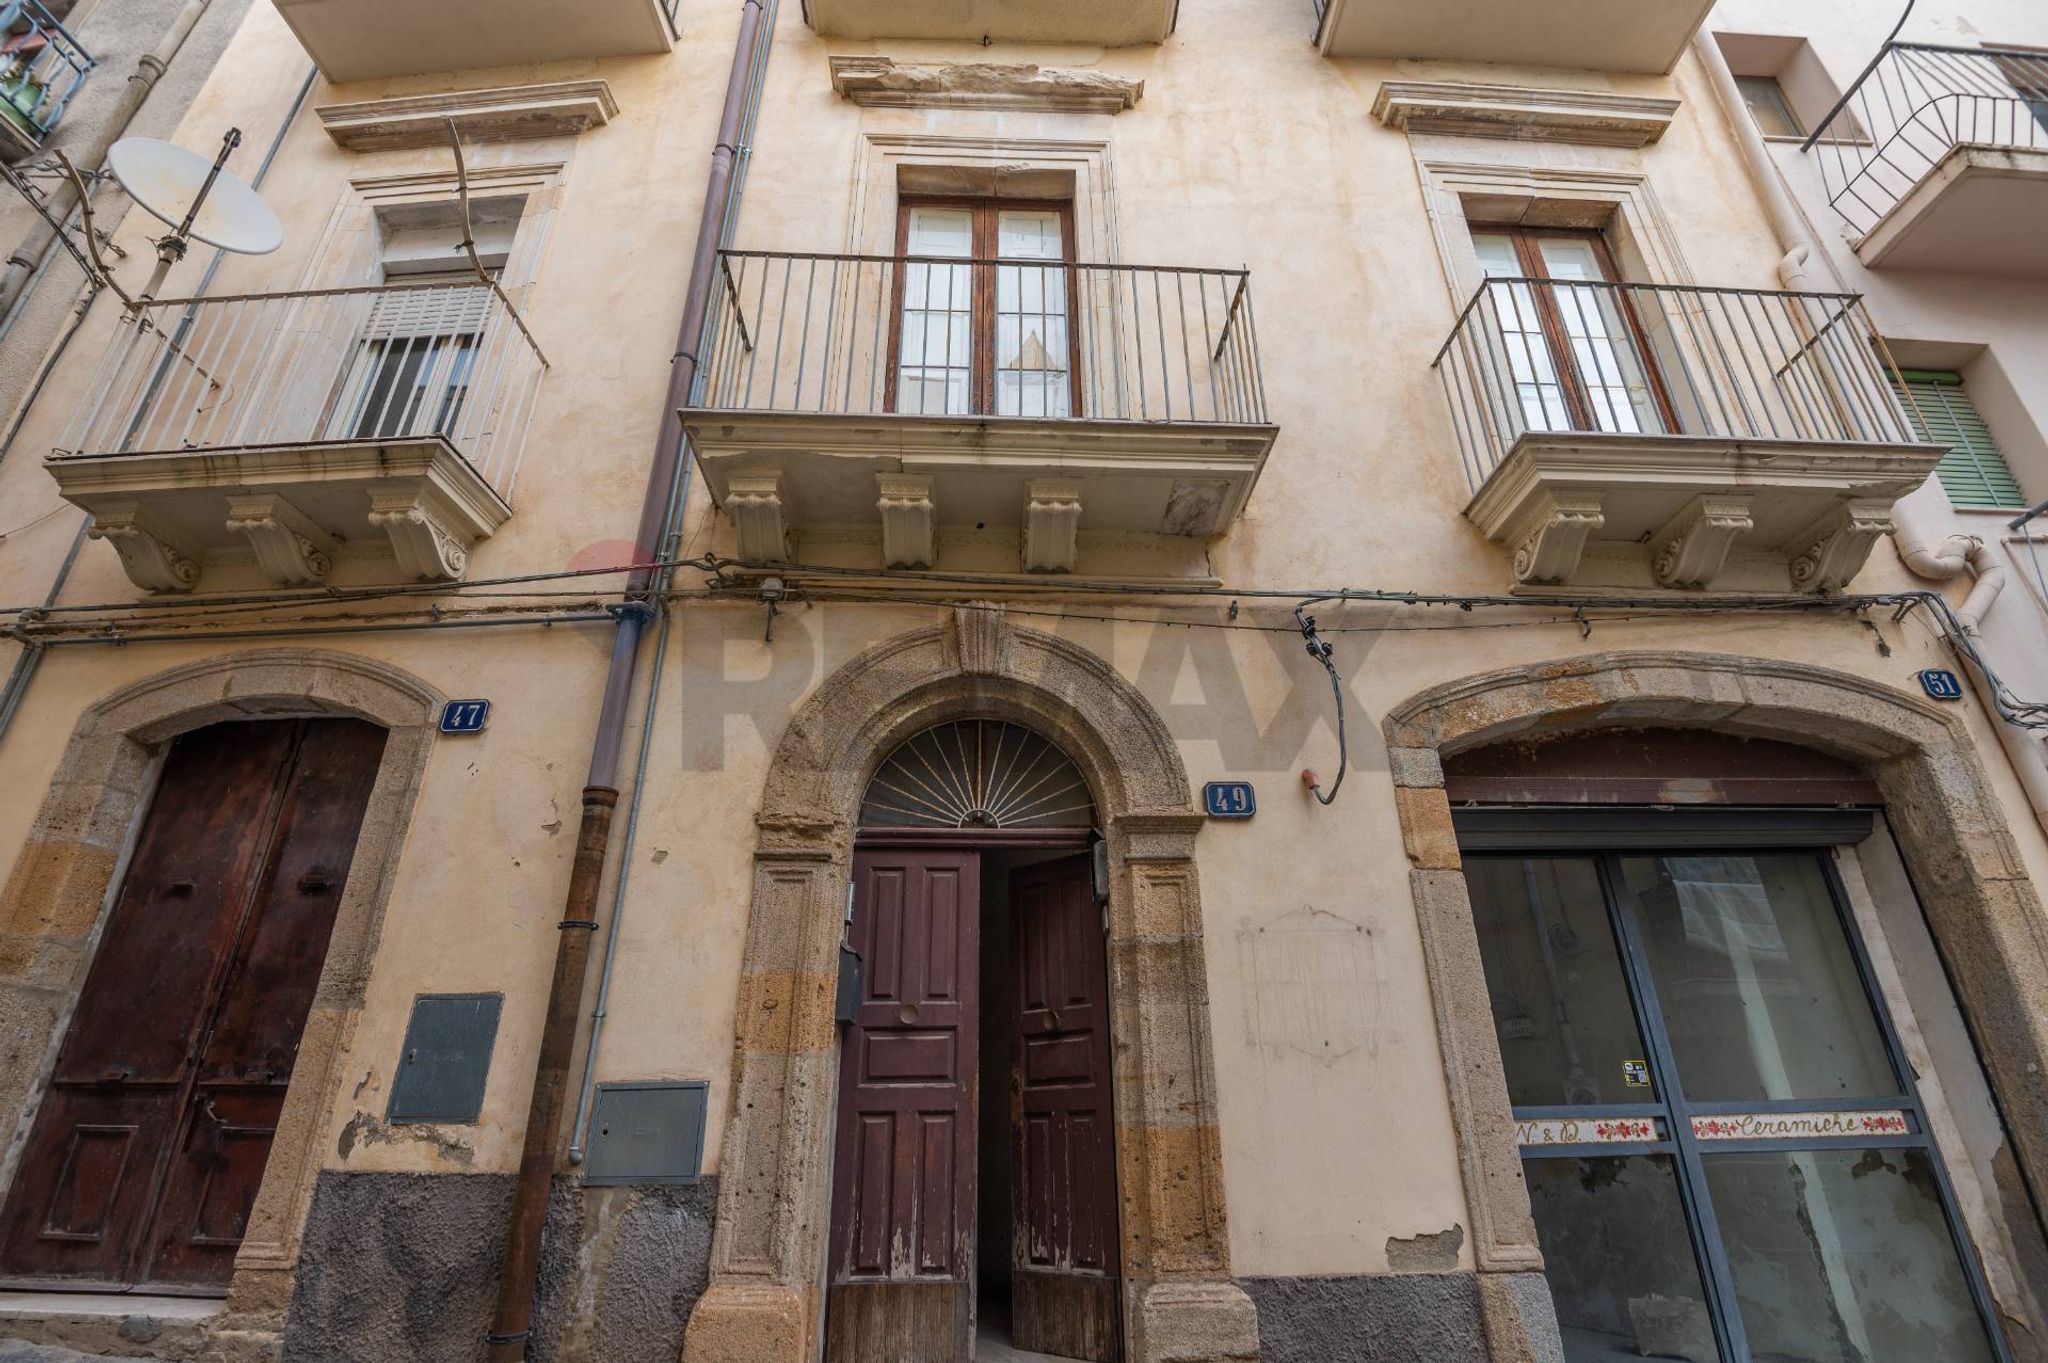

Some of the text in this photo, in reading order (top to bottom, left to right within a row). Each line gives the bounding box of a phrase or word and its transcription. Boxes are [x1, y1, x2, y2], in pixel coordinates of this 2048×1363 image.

[1928, 672, 1957, 694] 51
[451, 704, 480, 727] 47
[1216, 786, 1247, 811] 49
[1543, 1128, 1554, 1142] &
[1735, 1114, 1860, 1136] Ceramiche
